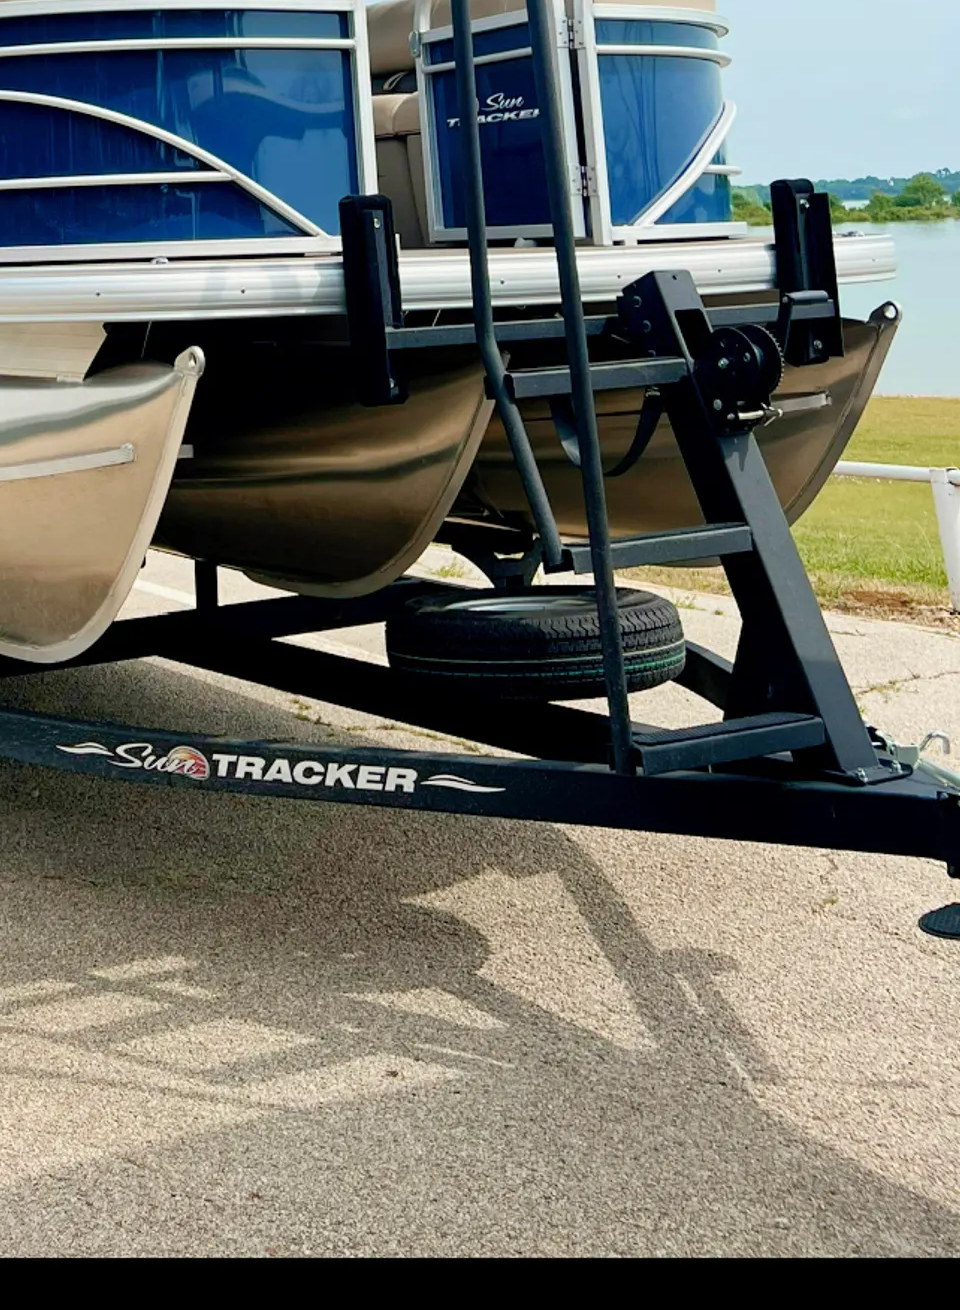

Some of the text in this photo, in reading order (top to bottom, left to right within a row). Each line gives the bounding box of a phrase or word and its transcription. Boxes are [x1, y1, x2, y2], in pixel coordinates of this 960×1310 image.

[481, 92, 524, 110] Sun
[107, 743, 418, 792] Sun TRACKER
